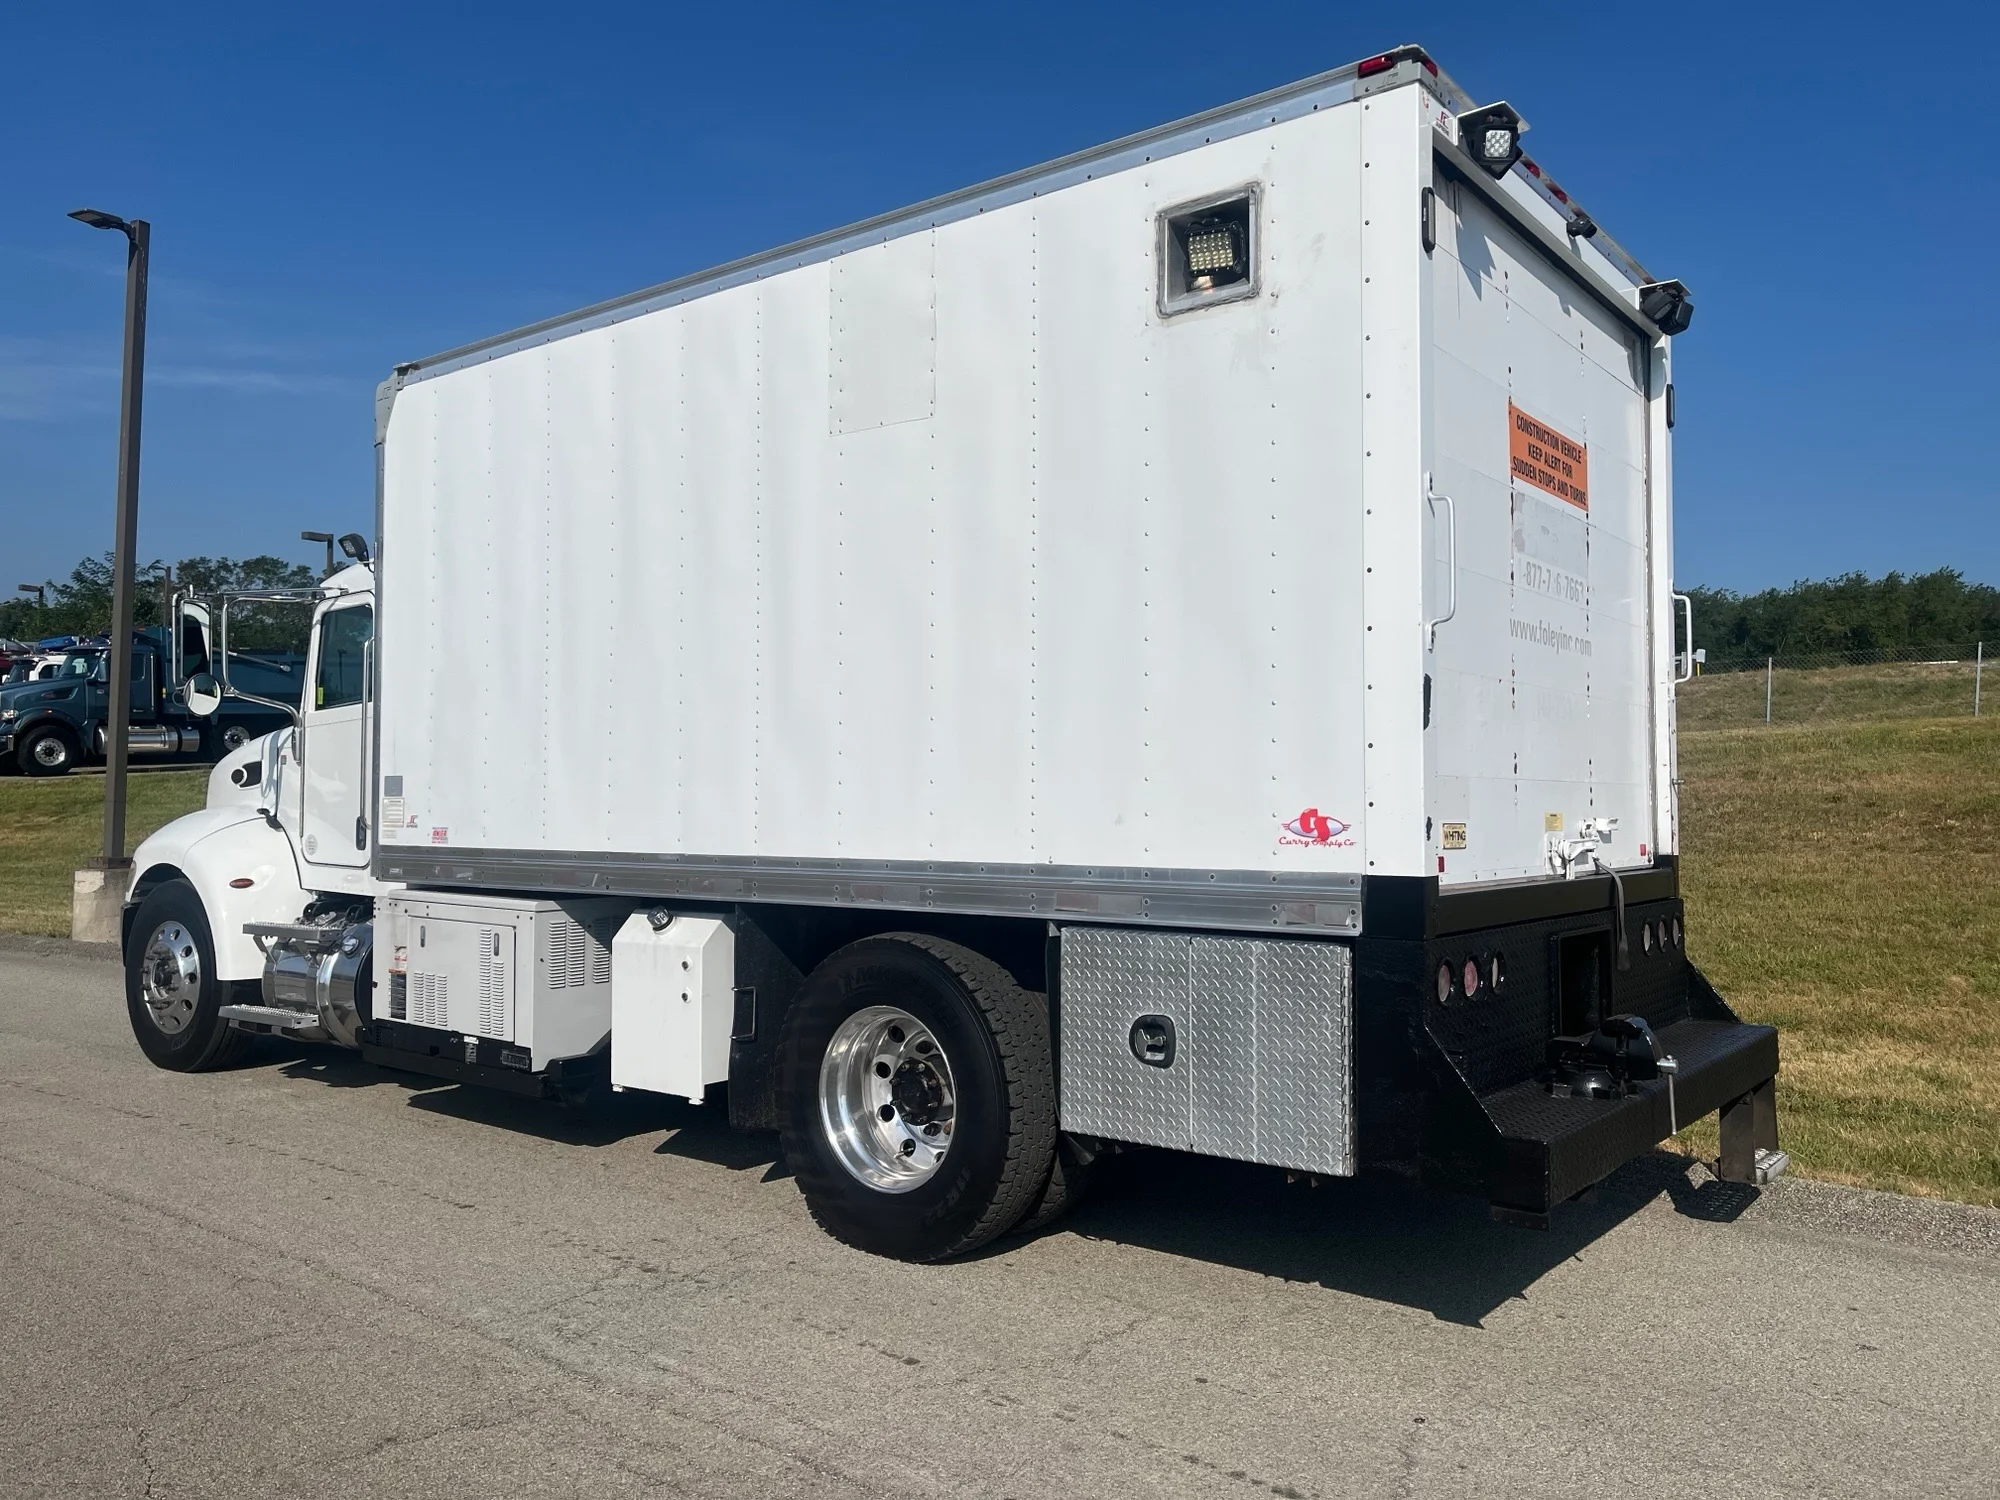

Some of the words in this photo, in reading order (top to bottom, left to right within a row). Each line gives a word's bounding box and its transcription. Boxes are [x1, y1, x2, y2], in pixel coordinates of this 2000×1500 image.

[1516, 414, 1559, 452] CONSTRUCTION
[1560, 439, 1582, 464] VEHICLE
[1512, 456, 1537, 479] SUDDEN
[1538, 469, 1557, 491] STOPS
[1557, 479, 1569, 497] AND
[1569, 485, 1587, 507] TURNS
[1528, 442, 1543, 463] KEEP
[1544, 451, 1561, 473] ALERT
[1562, 460, 1573, 480] FOR
[1509, 617, 1592, 658] www.foleyinc.com
[1278, 836, 1310, 848] Curry
